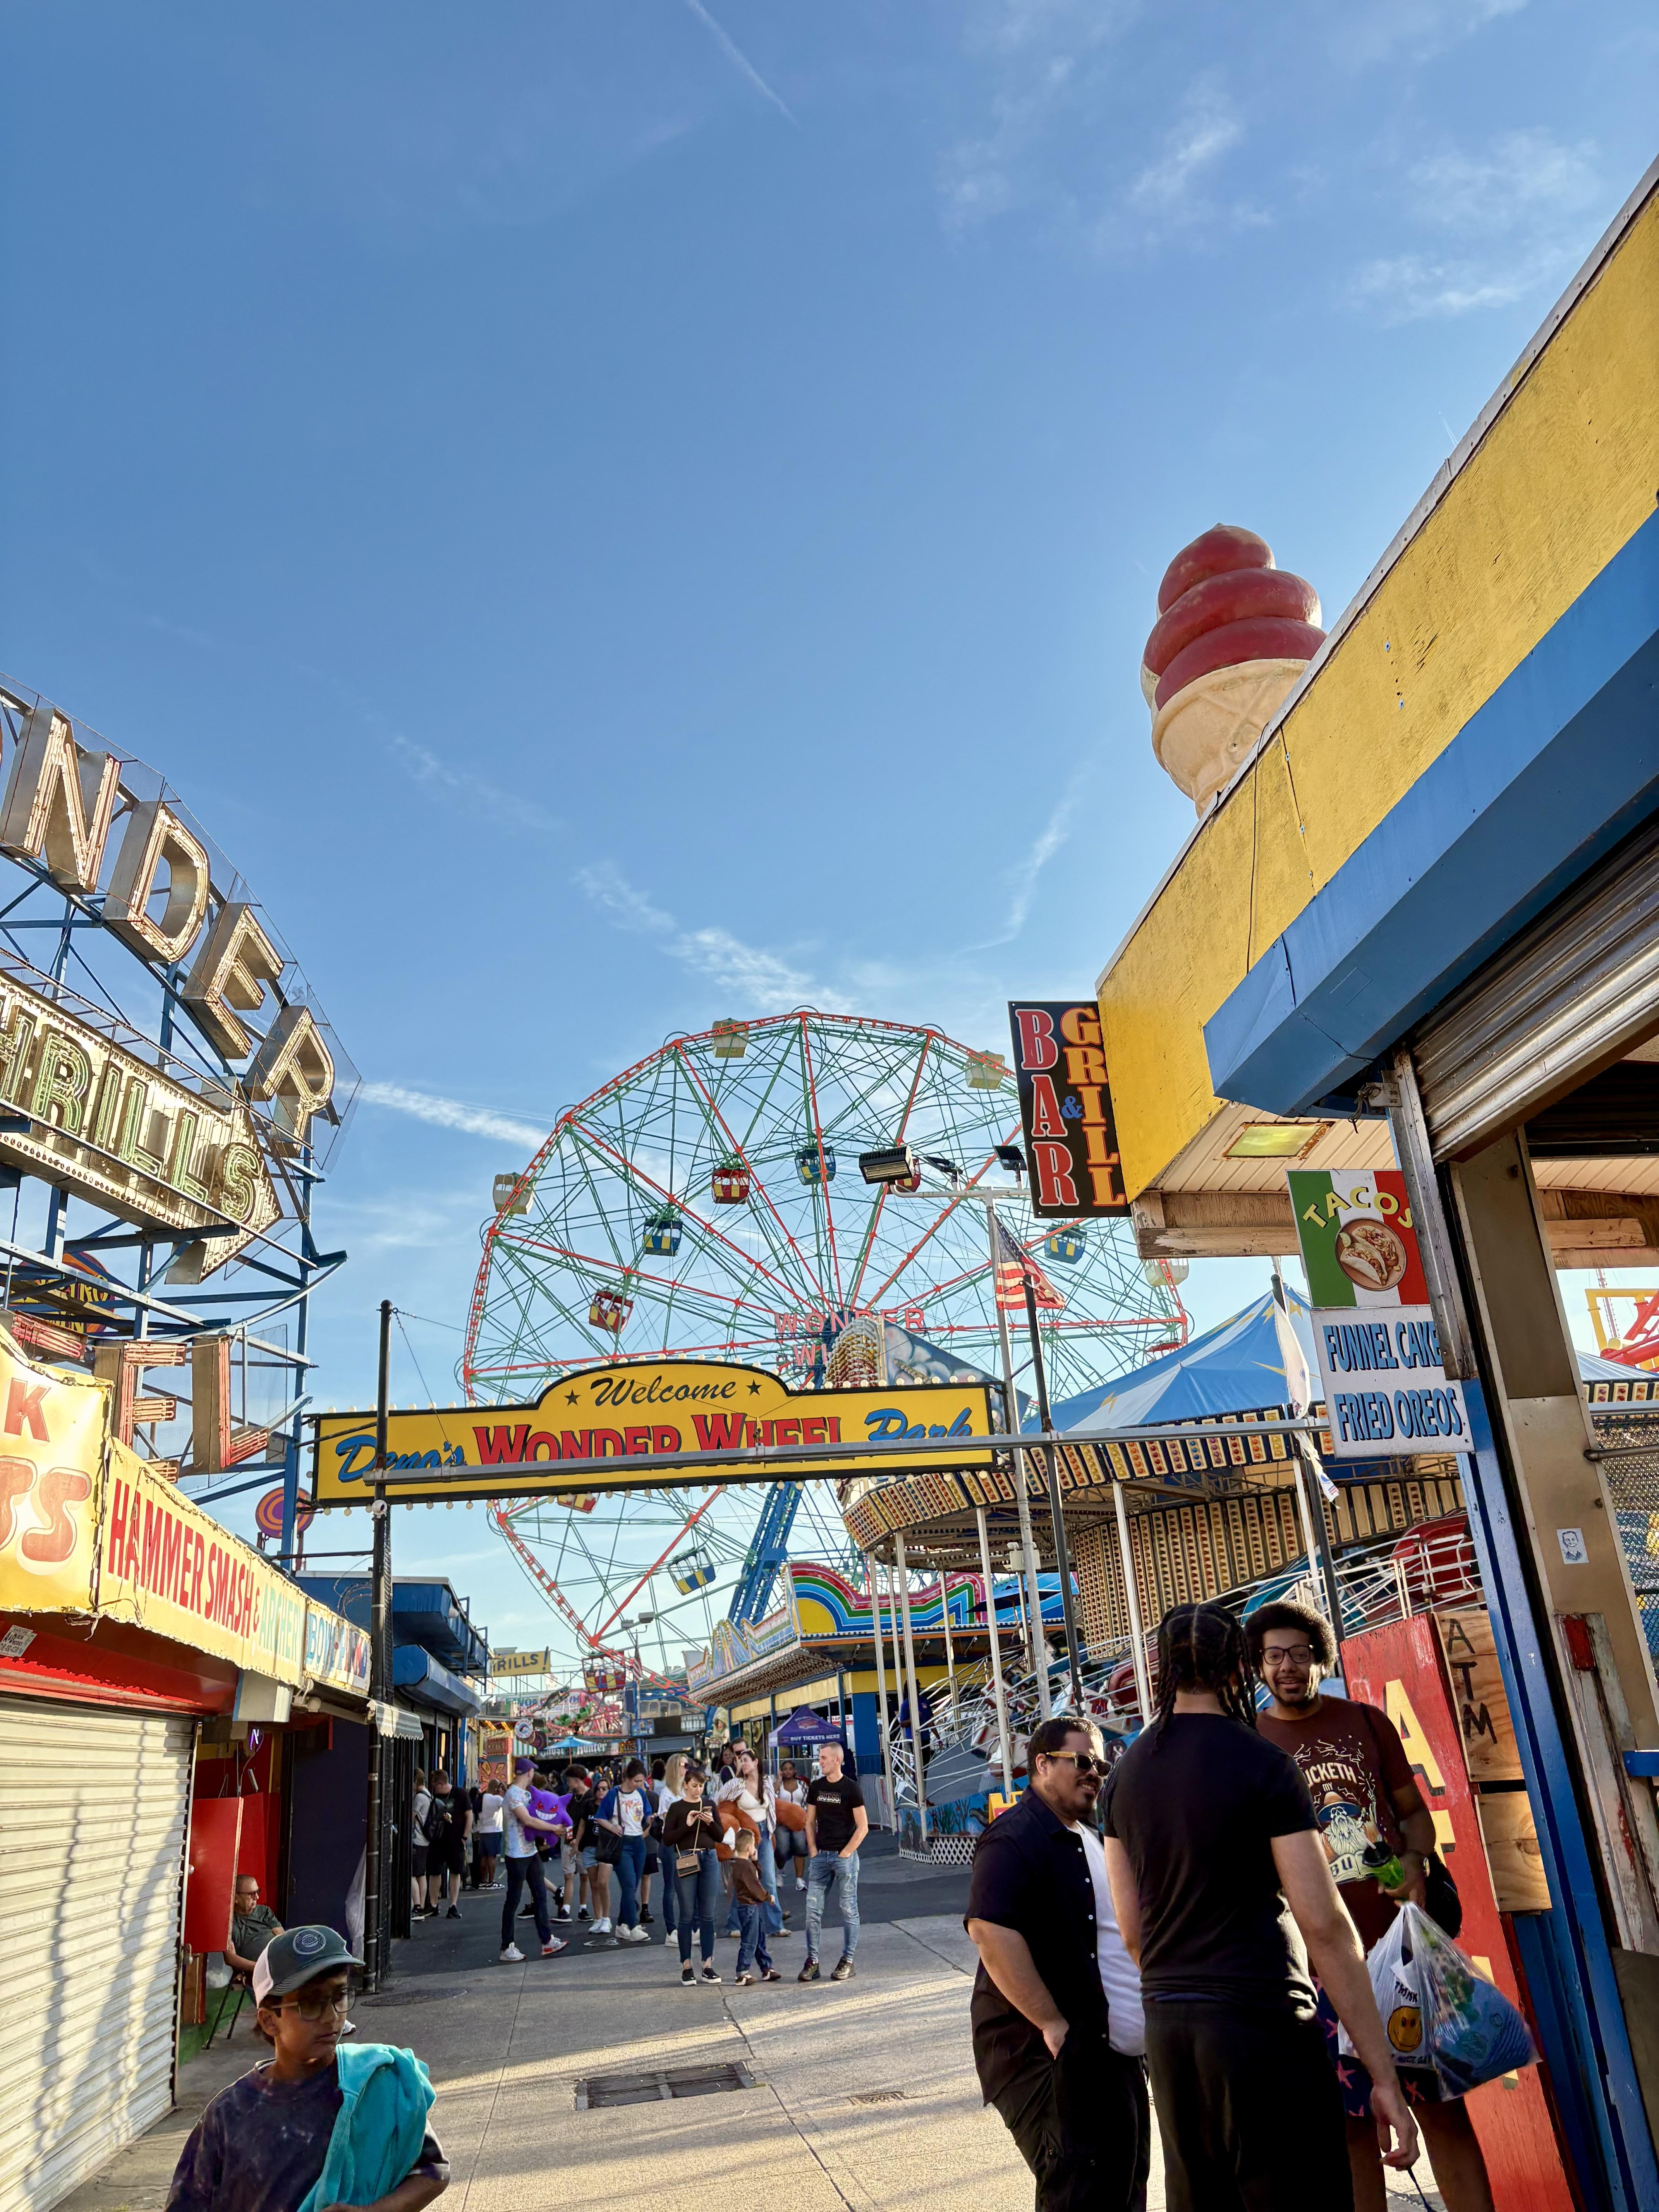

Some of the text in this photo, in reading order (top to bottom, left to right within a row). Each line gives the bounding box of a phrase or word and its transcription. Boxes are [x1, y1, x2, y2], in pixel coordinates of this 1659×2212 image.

[0, 707, 335, 1158] NDER
[1015, 1007, 1125, 1207] BAR & GRILL
[1302, 1187, 1413, 1229] TACOS
[1323, 1321, 1444, 1372] FUNNEL CAKE
[591, 1375, 737, 1407] Welcome
[1334, 1387, 1463, 1442] FRIED OREOS
[335, 1407, 972, 1482] Deno's WONDER WHEEL Park
[108, 1478, 205, 1614] HAMMER
[205, 1542, 254, 1639] SMASH
[1448, 1618, 1498, 1744] ATM
[818, 1793, 840, 1802] GUESS
